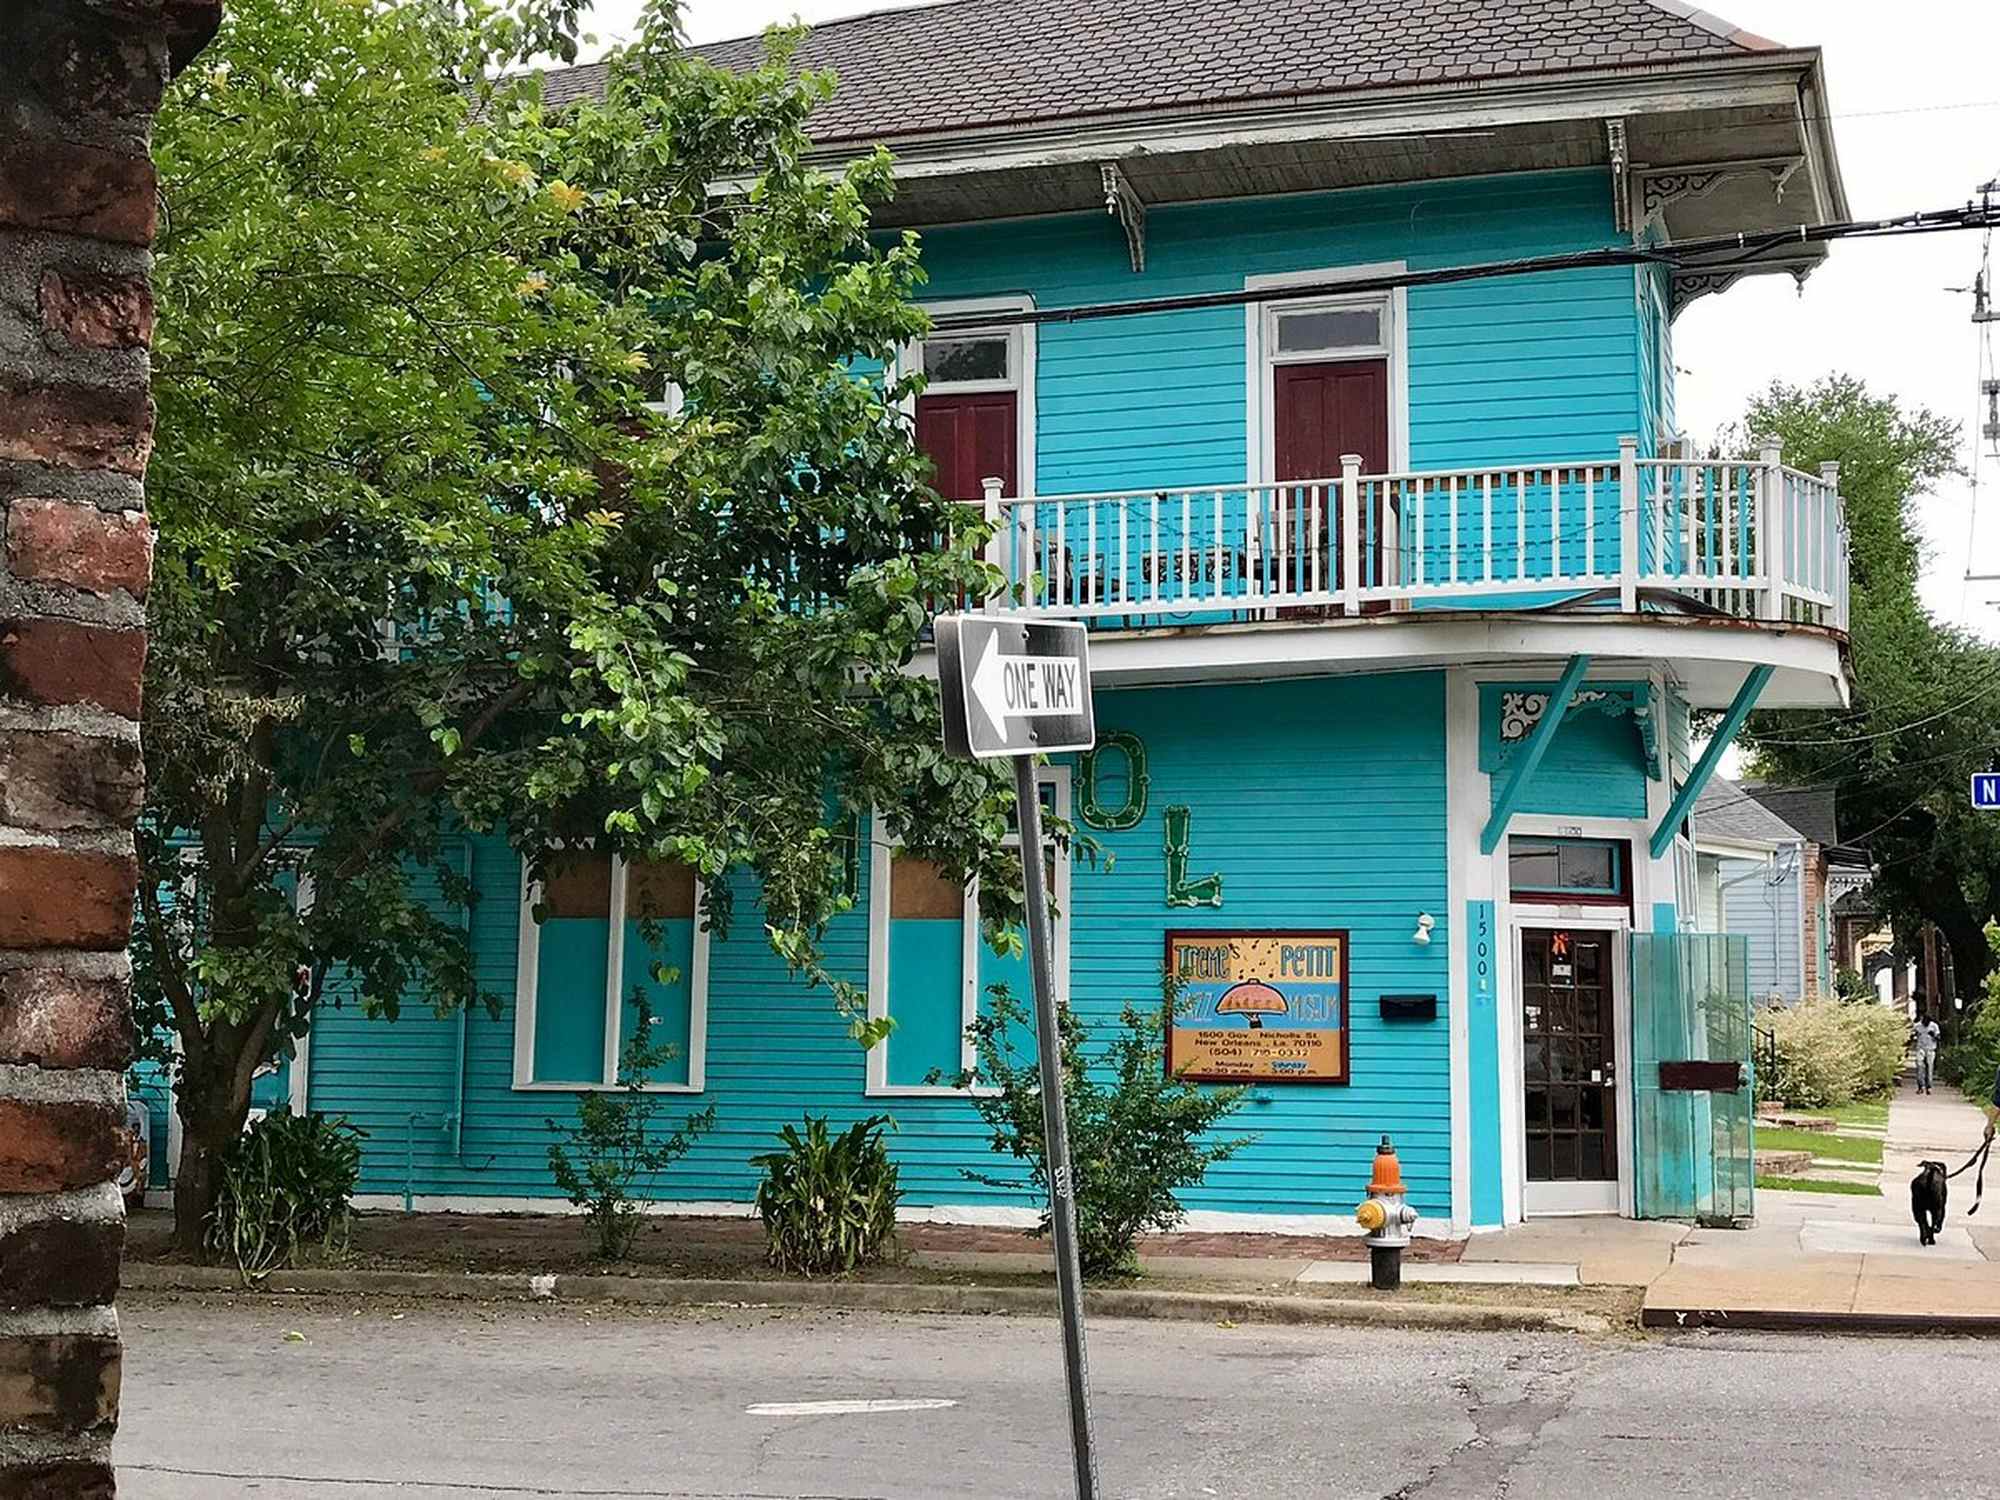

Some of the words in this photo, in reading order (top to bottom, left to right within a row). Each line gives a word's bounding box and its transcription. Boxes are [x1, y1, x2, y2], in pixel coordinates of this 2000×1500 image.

[1003, 661, 1038, 710] ONE
[1042, 662, 1075, 709] WAY
[1983, 779, 1996, 802] N
[1477, 903, 1488, 976] 1500
[1209, 1047, 1242, 1056] (504)
[1215, 1060, 1254, 1068] Monday
